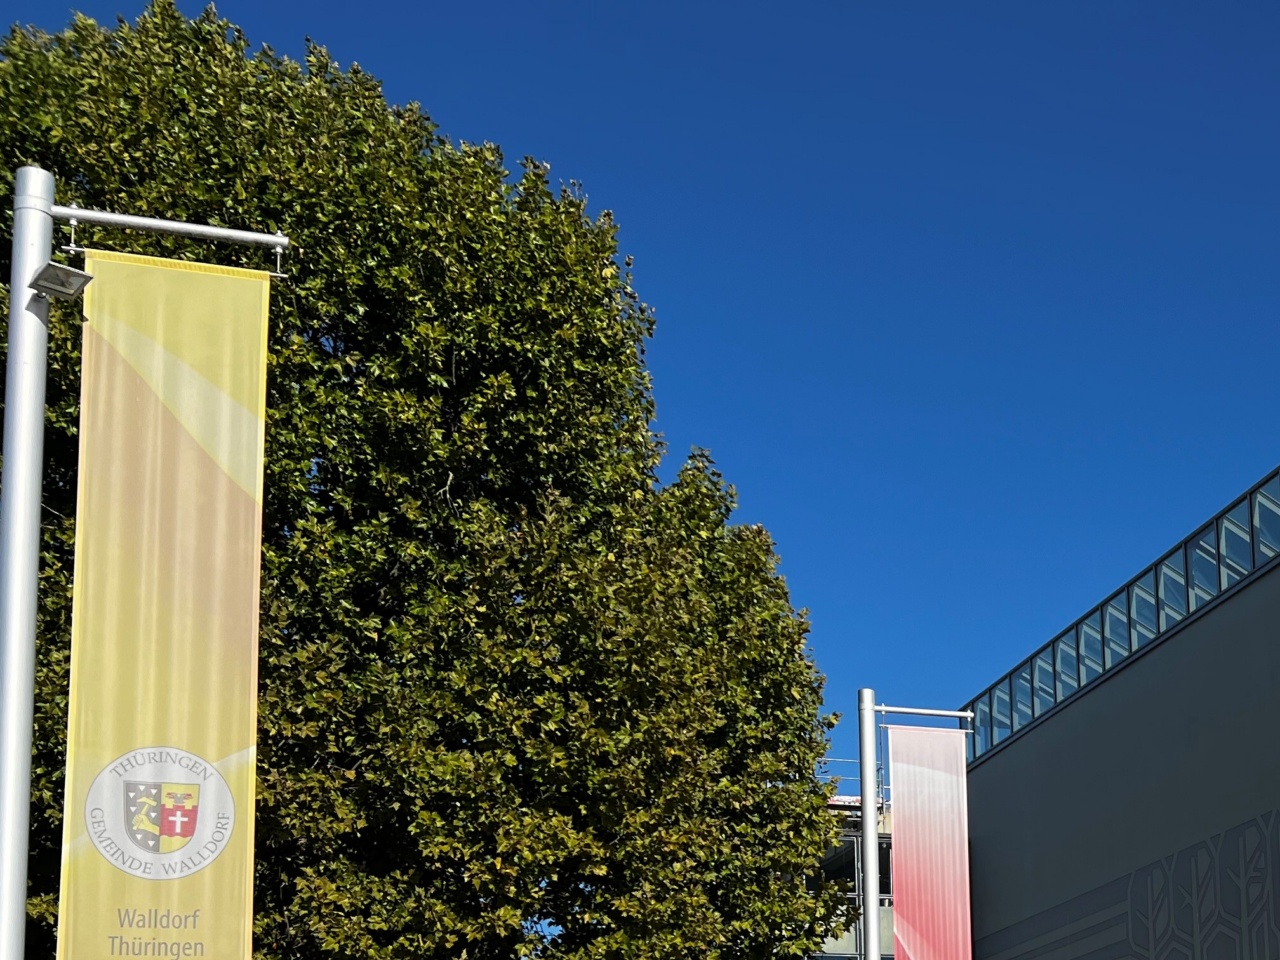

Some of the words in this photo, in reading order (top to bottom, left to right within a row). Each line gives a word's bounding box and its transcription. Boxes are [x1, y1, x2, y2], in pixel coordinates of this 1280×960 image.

[109, 751, 214, 782] THÜRINGEN
[89, 807, 154, 875] GEMEINDE
[161, 811, 230, 876] WALLDORF
[117, 908, 201, 929] Walldorf
